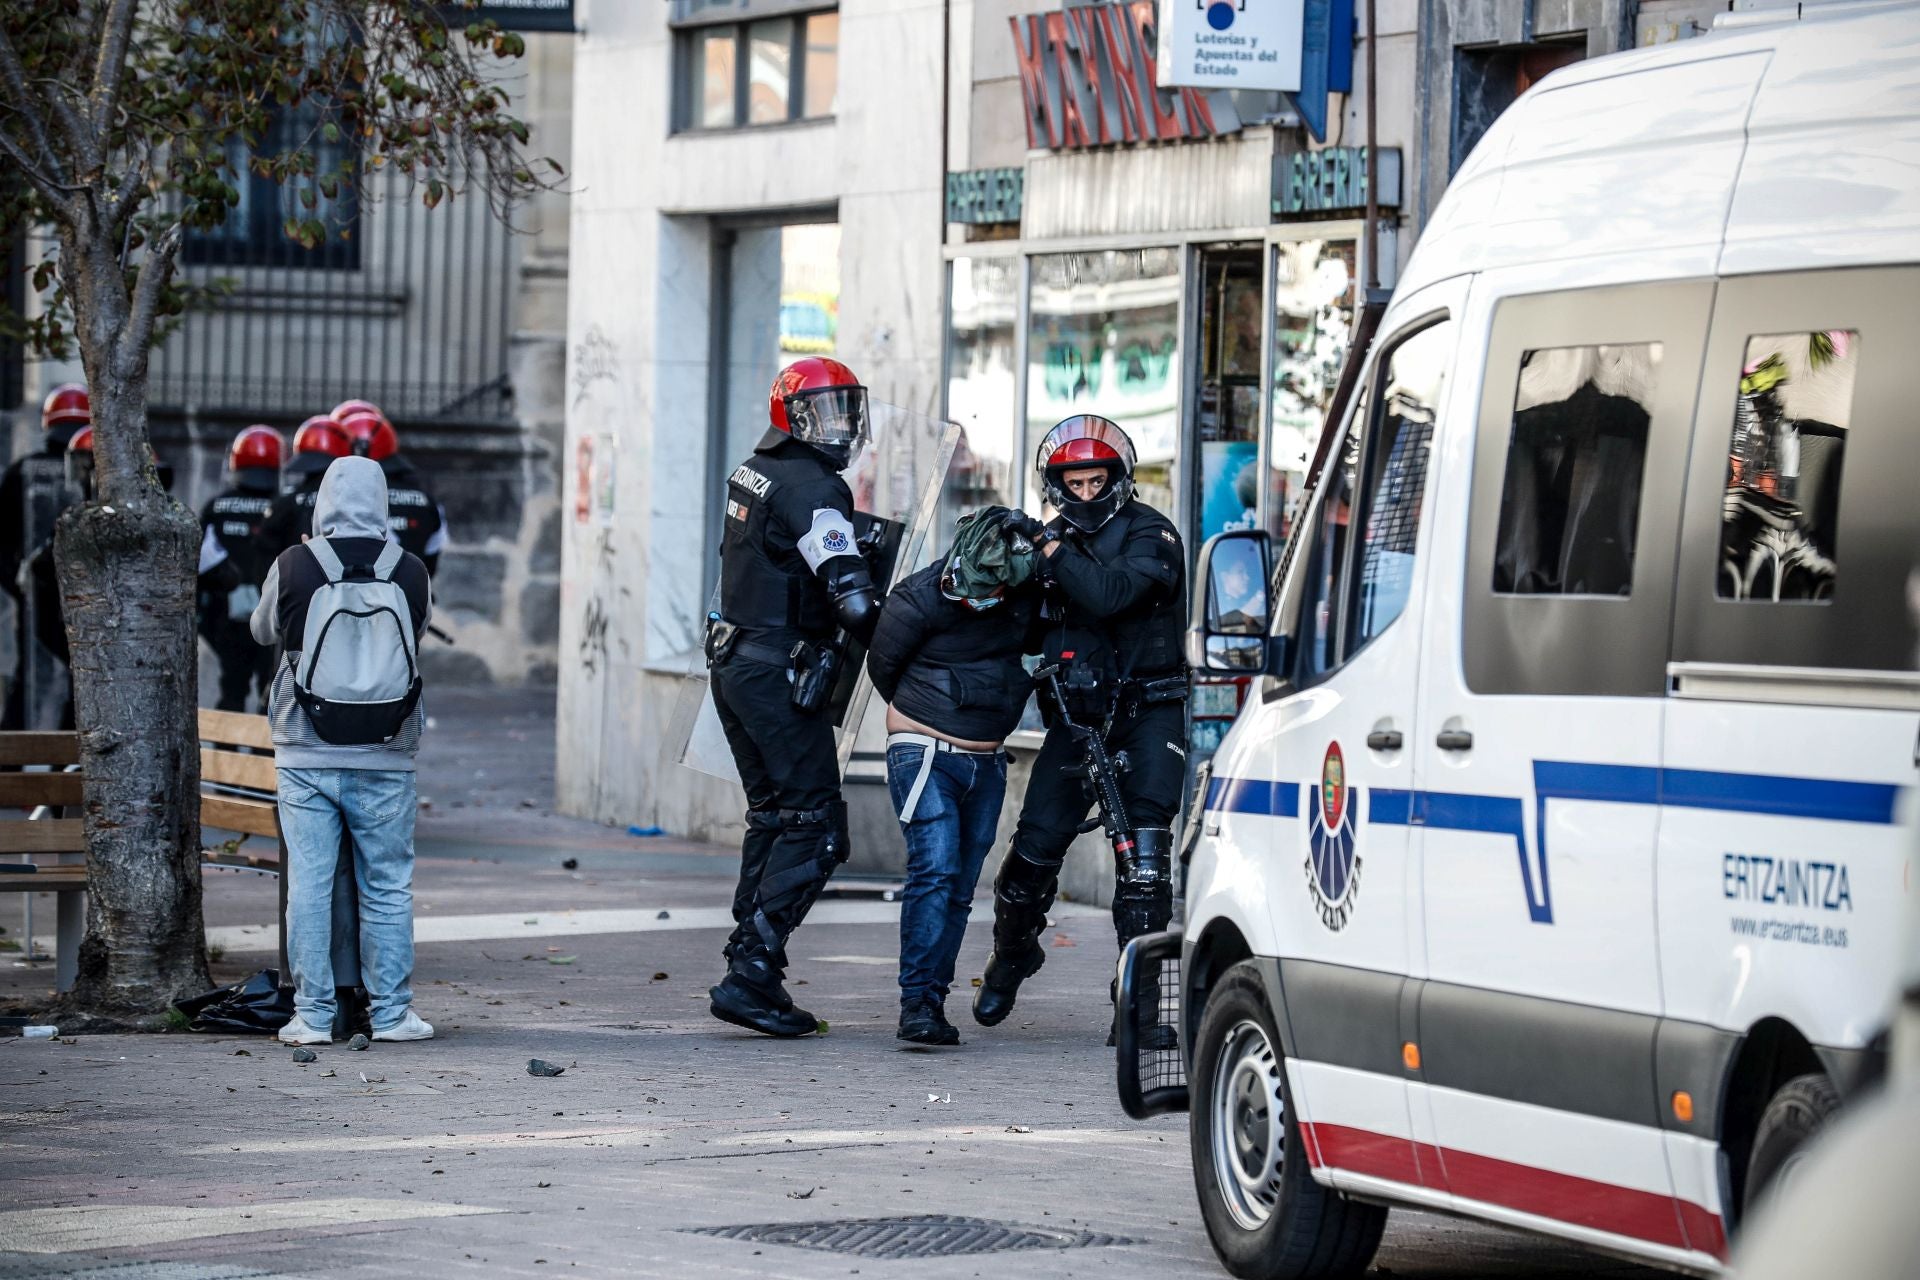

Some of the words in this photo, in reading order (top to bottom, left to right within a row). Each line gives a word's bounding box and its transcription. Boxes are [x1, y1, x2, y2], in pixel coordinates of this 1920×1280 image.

[1250, 37, 1258, 48] y
[1194, 48, 1254, 61] Apuestas
[1258, 50, 1278, 61] del
[1194, 63, 1238, 75] Estado
[1723, 854, 1853, 911] ERTZAINTZA
[1731, 917, 1848, 947] www.ertzaintza.eus
